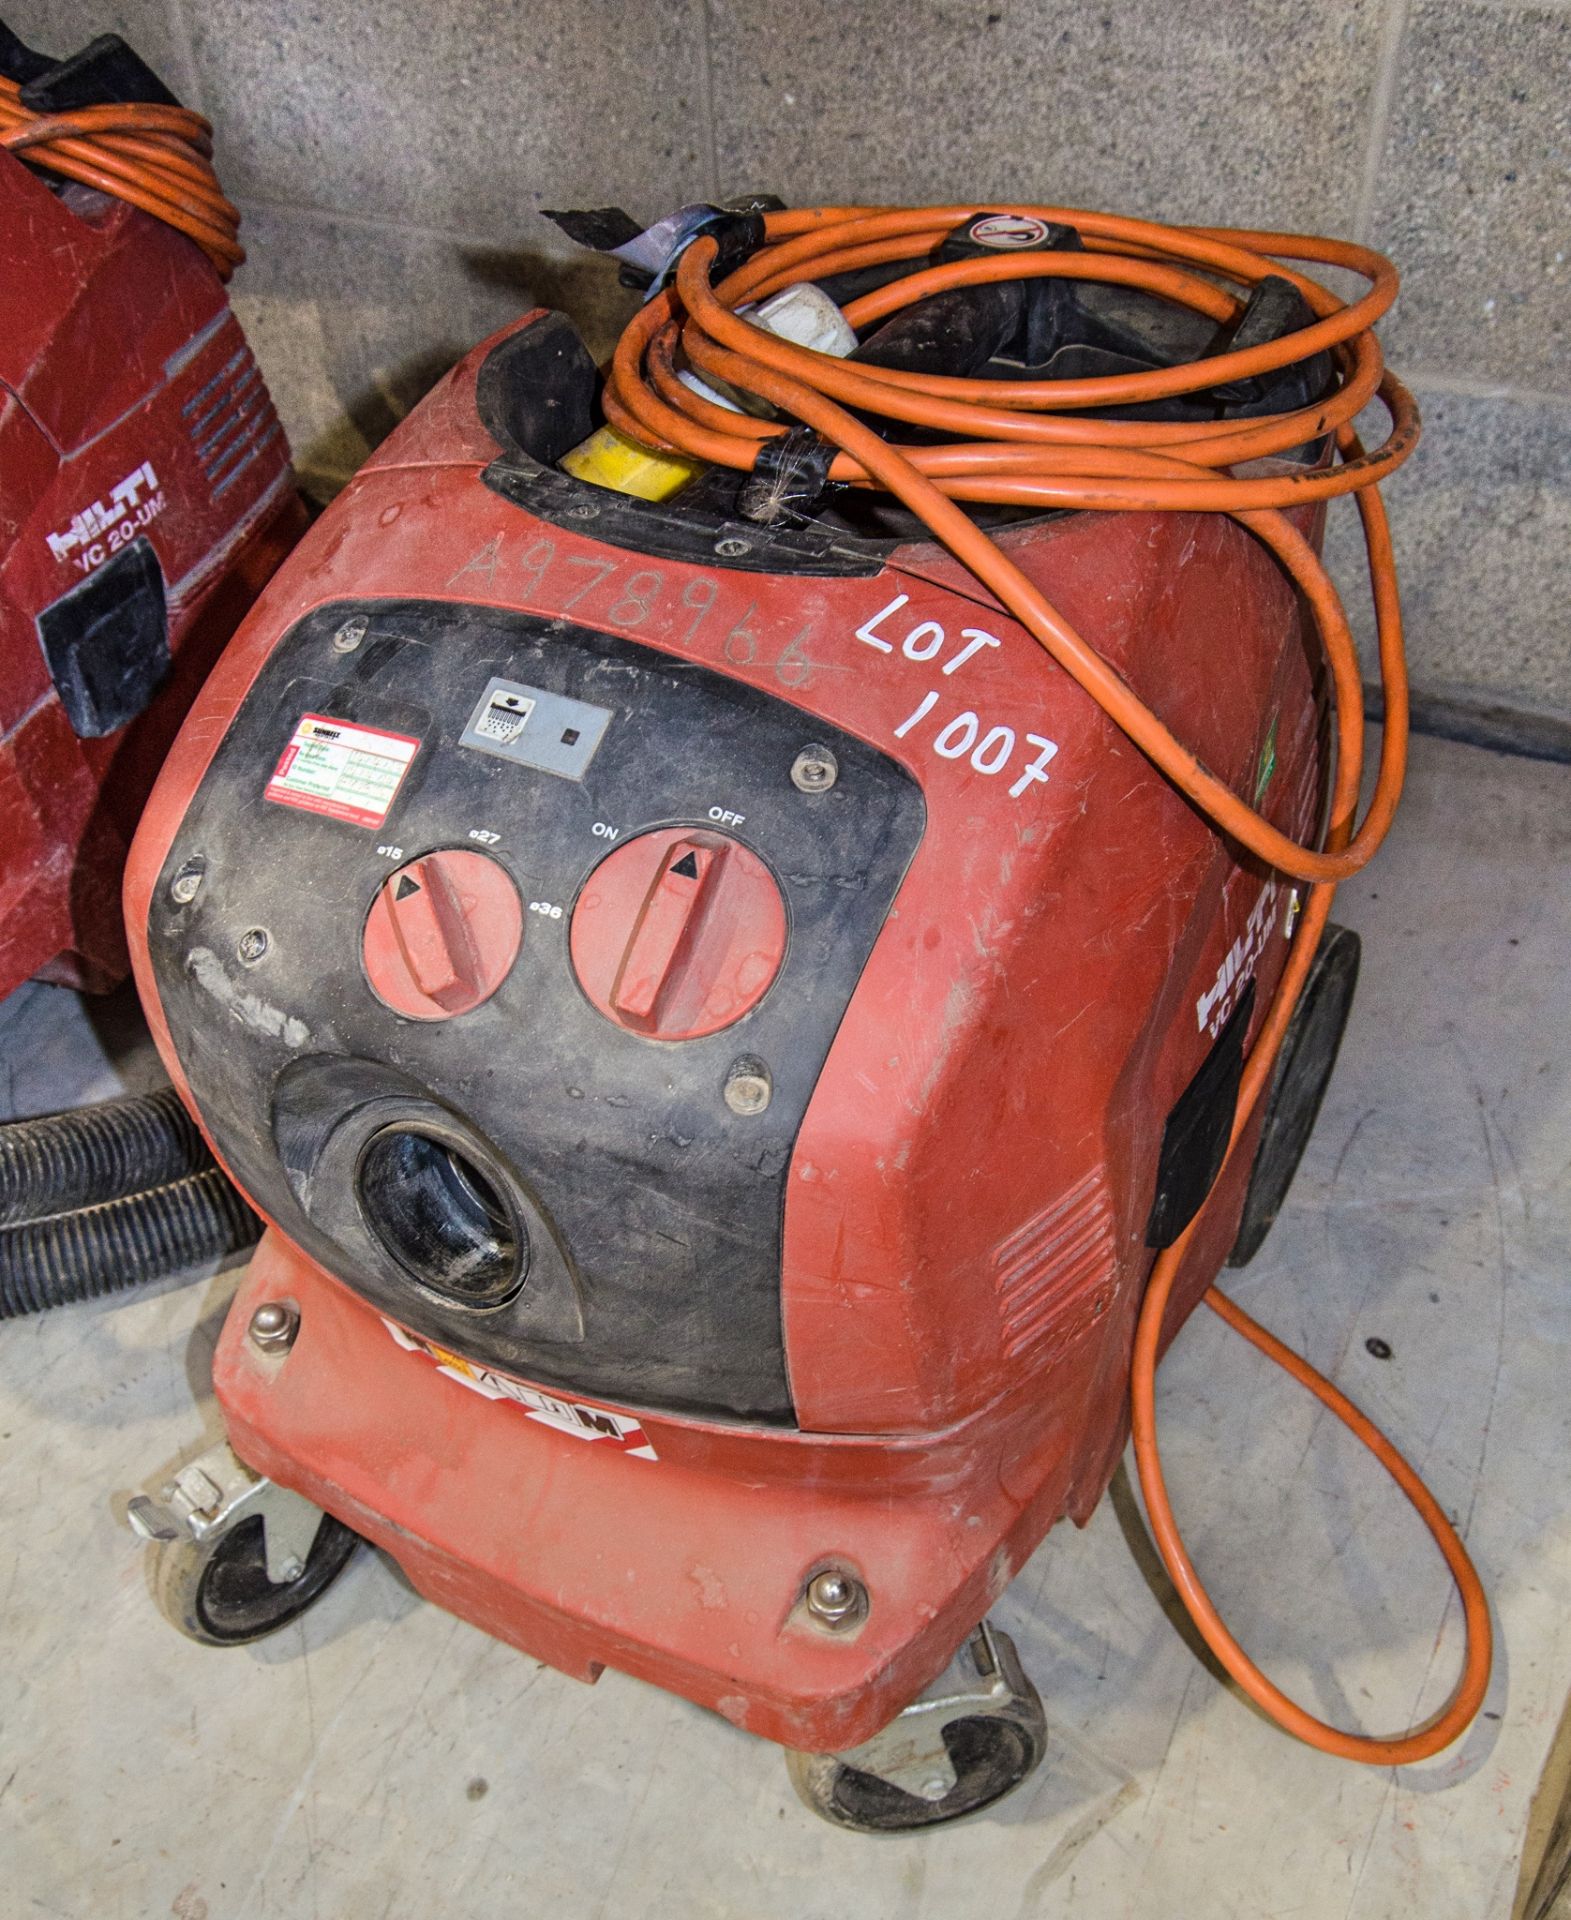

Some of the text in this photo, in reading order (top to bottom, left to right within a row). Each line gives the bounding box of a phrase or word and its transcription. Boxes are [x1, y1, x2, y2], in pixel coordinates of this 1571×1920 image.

[46, 460, 159, 563] HILTI
[72, 490, 167, 573] VC 20-UM
[446, 531, 812, 688] A978966
[855, 594, 1001, 675] LOT
[894, 691, 1058, 798] 1007
[591, 822, 619, 841] ON
[708, 806, 746, 827] OFF
